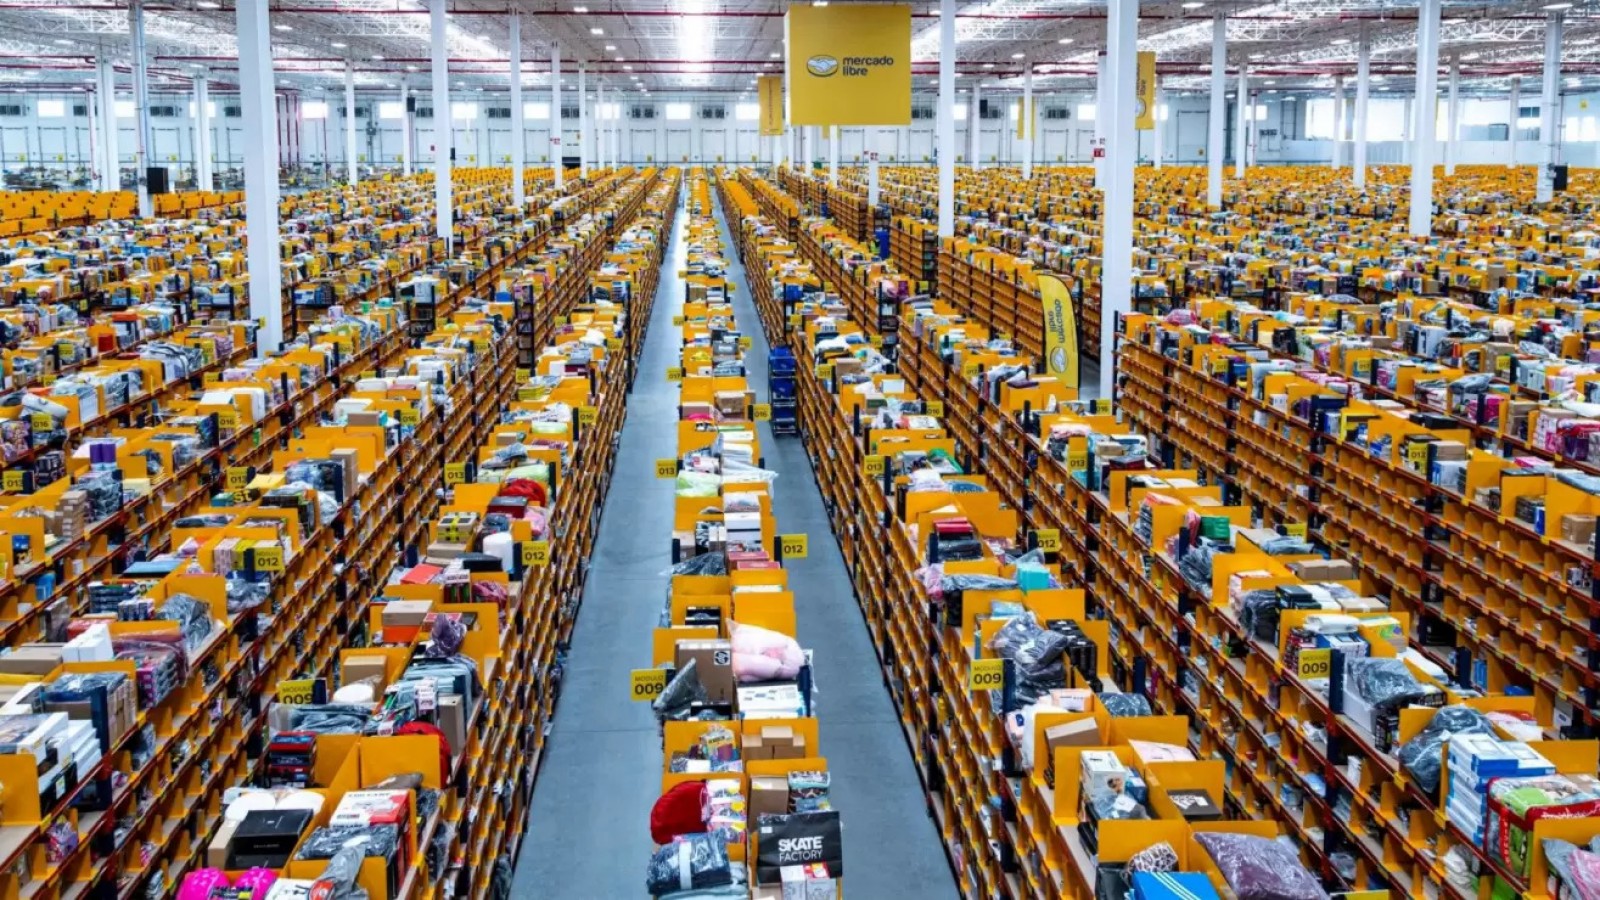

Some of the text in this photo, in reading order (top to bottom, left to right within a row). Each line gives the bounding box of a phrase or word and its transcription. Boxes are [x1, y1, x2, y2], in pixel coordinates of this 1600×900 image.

[843, 56, 894, 66] mercado
[843, 66, 868, 76] libre
[220, 417, 234, 425] 016
[867, 463, 882, 471] 013
[1070, 459, 1085, 467] 013
[448, 471, 465, 479] 013
[659, 467, 675, 475] 013
[1038, 539, 1056, 548] 012
[784, 544, 803, 554] 012
[525, 551, 545, 561] 012
[258, 557, 278, 567] 012
[1302, 662, 1328, 674] 009
[973, 673, 1001, 684] 009
[634, 683, 664, 695] 009
[283, 693, 313, 704] 009
[778, 835, 824, 852] SKATE
[779, 849, 823, 862] FACTORY
